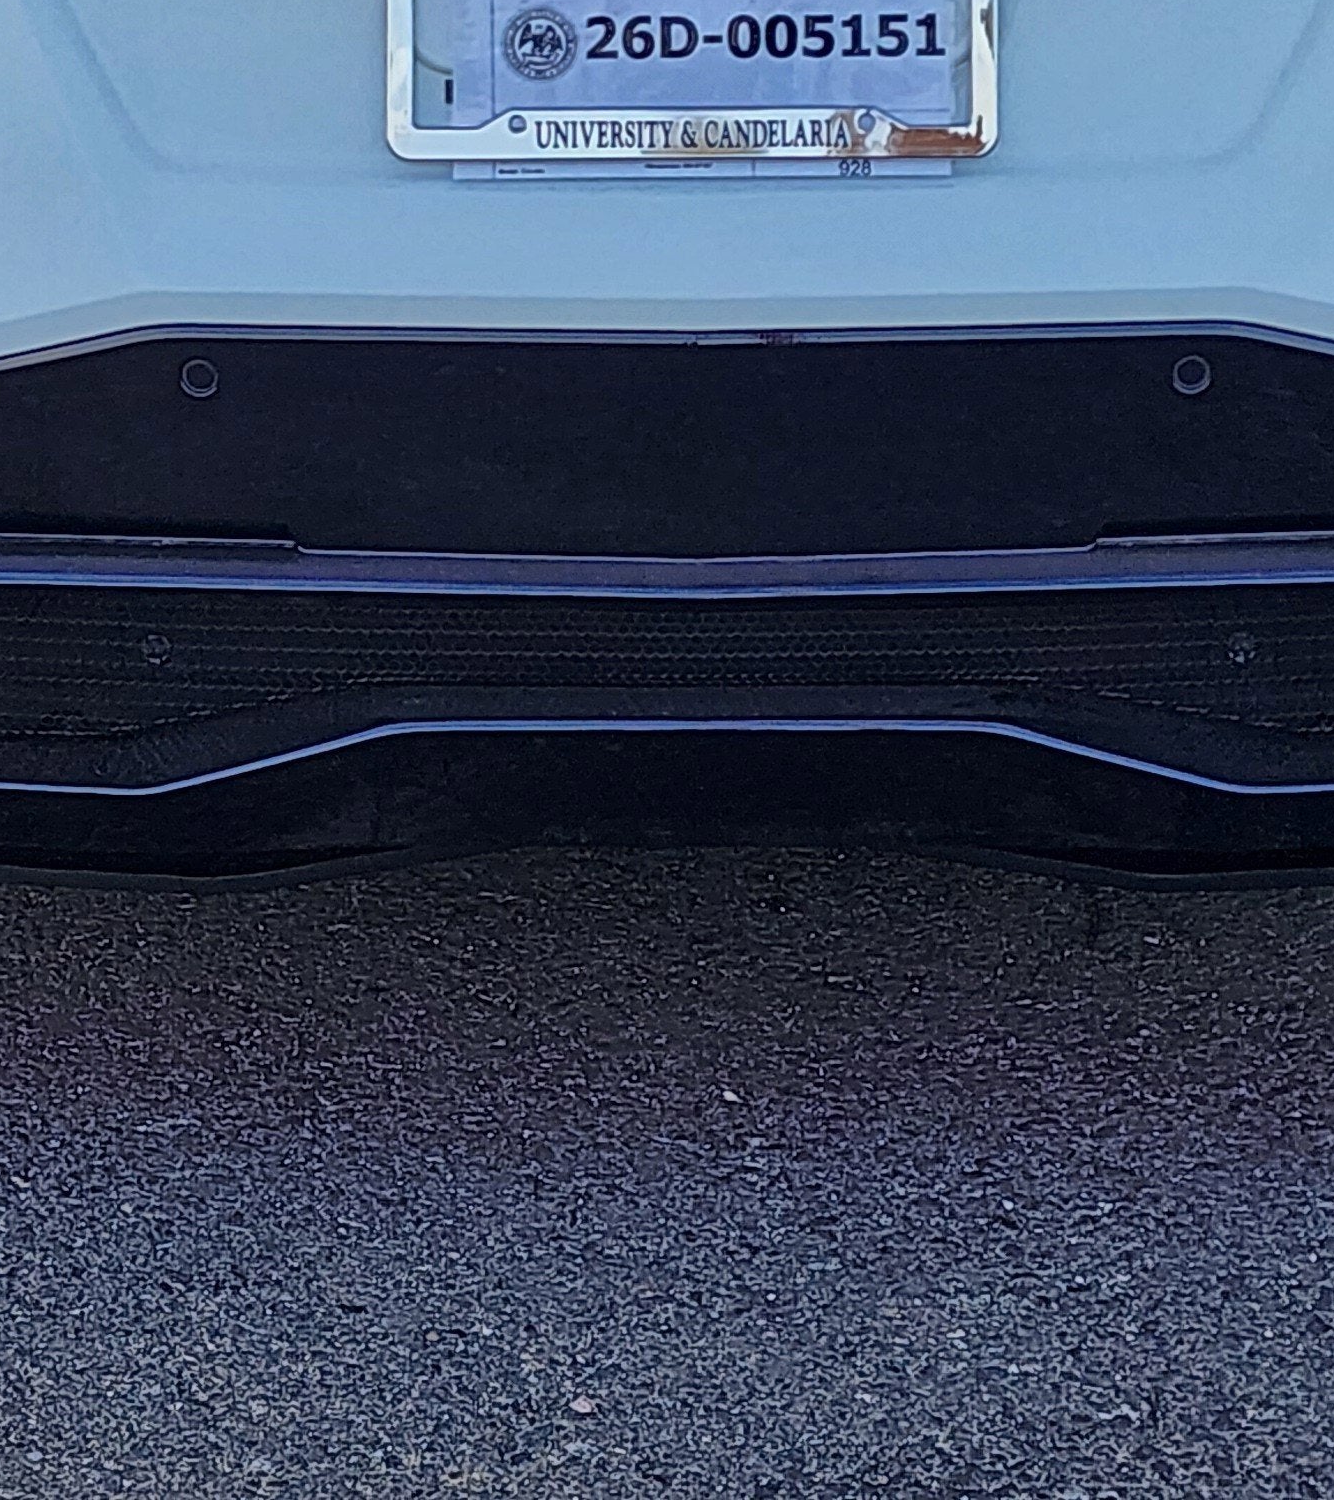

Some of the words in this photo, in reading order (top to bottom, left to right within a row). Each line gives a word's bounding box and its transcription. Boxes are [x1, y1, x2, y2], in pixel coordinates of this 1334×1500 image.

[585, 13, 946, 59] 26D-005151
[535, 120, 674, 149] UNIVERSITY
[681, 120, 698, 148] &
[704, 119, 849, 148] CANDELARIA
[839, 159, 872, 177] 928
